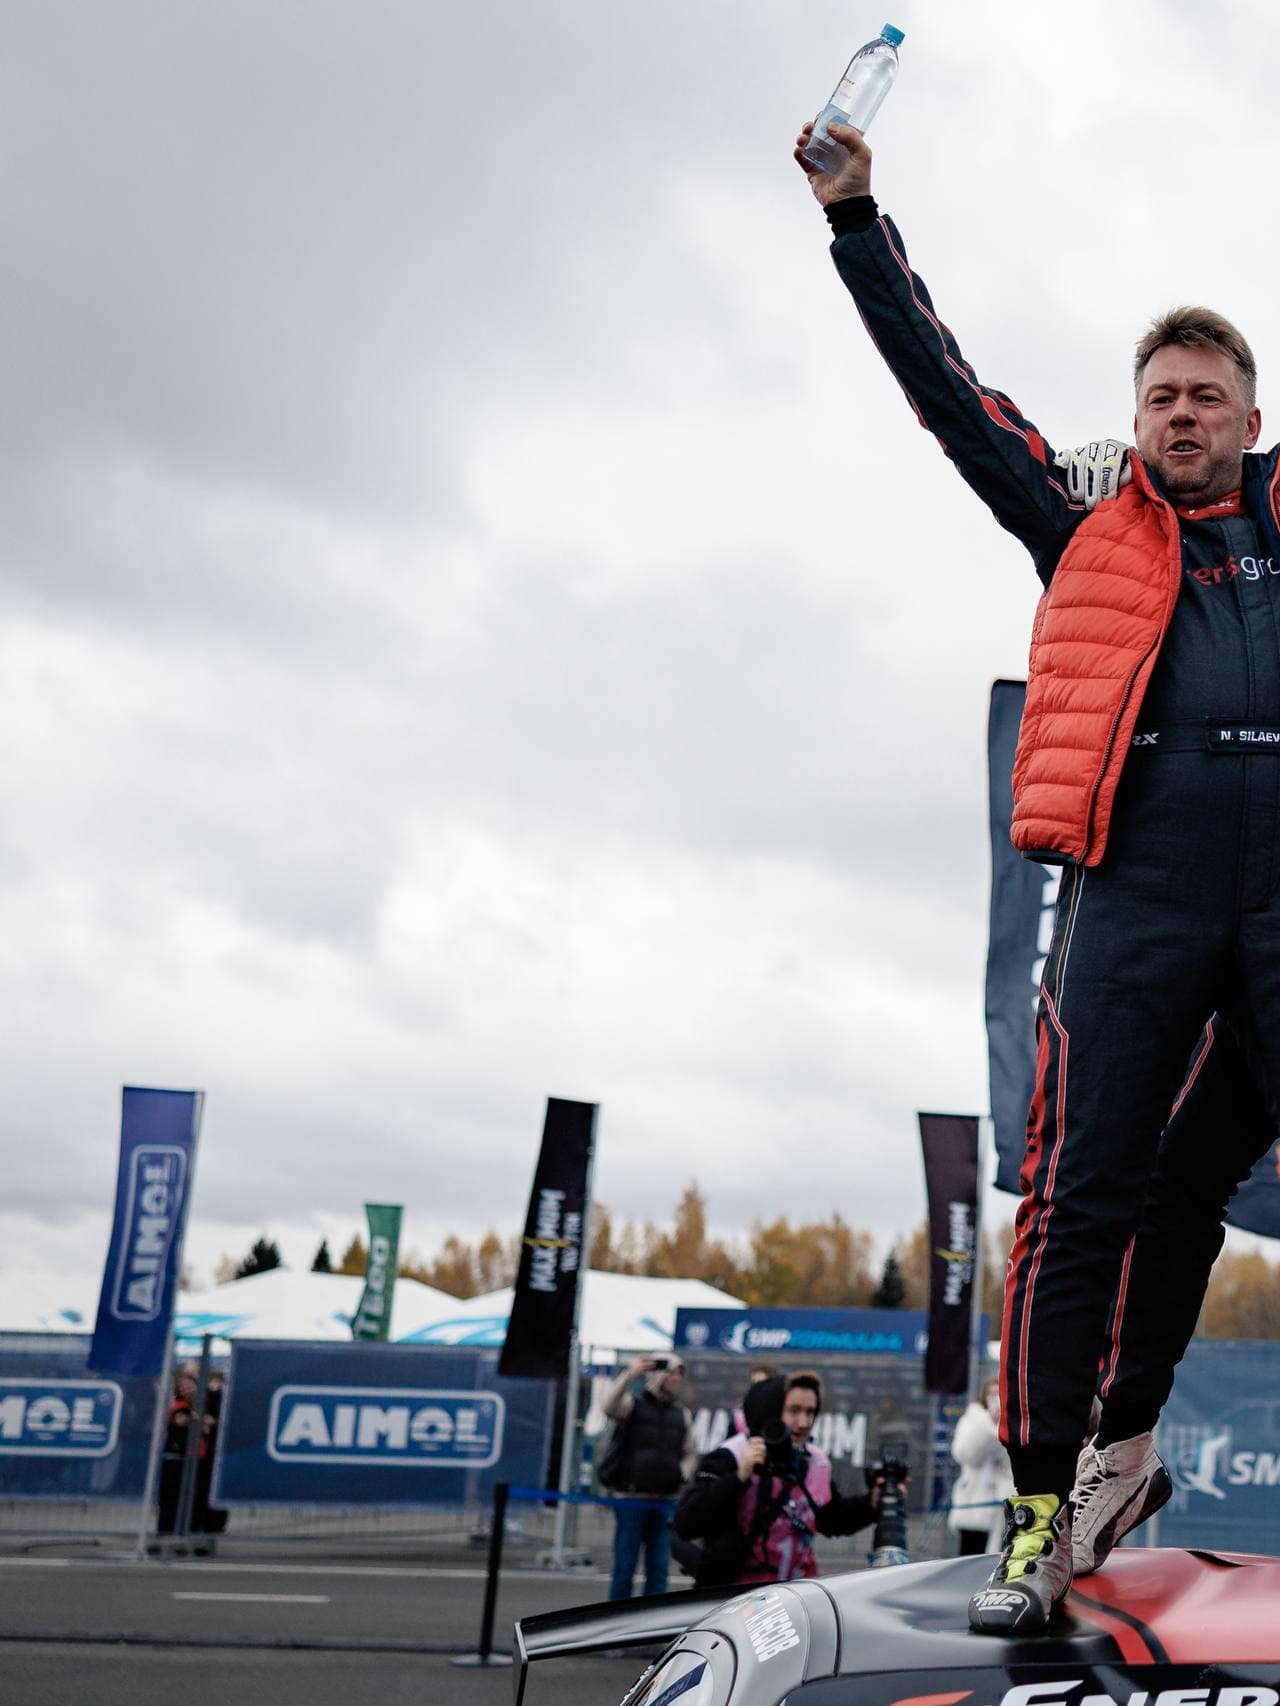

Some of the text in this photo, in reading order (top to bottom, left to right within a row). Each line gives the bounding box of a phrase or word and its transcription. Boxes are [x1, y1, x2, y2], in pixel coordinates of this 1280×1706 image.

[1132, 732, 1160, 746] RX
[1220, 730, 1280, 743] N. SILAEV
[127, 1155, 172, 1312] AIMOL
[278, 1403, 490, 1449] AIMOL
